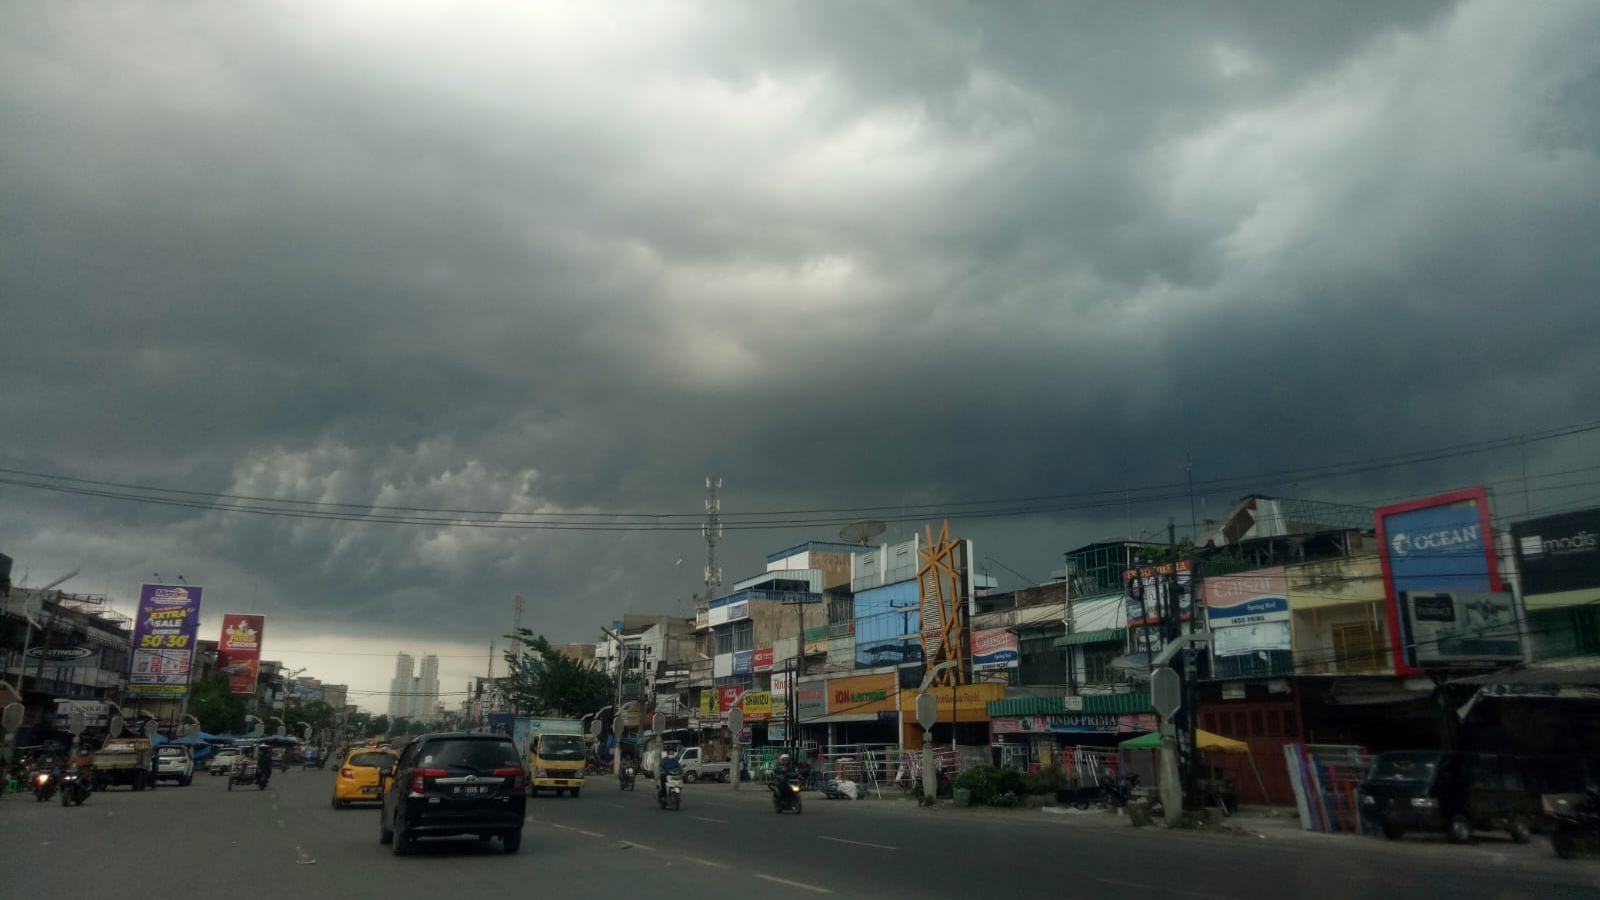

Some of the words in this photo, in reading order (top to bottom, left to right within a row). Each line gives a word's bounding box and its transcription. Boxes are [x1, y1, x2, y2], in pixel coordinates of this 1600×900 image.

[1414, 525, 1477, 550] OCEAN
[150, 609, 187, 620] EXTRA
[152, 619, 184, 628] SALE
[745, 694, 769, 706] SHIMIZU
